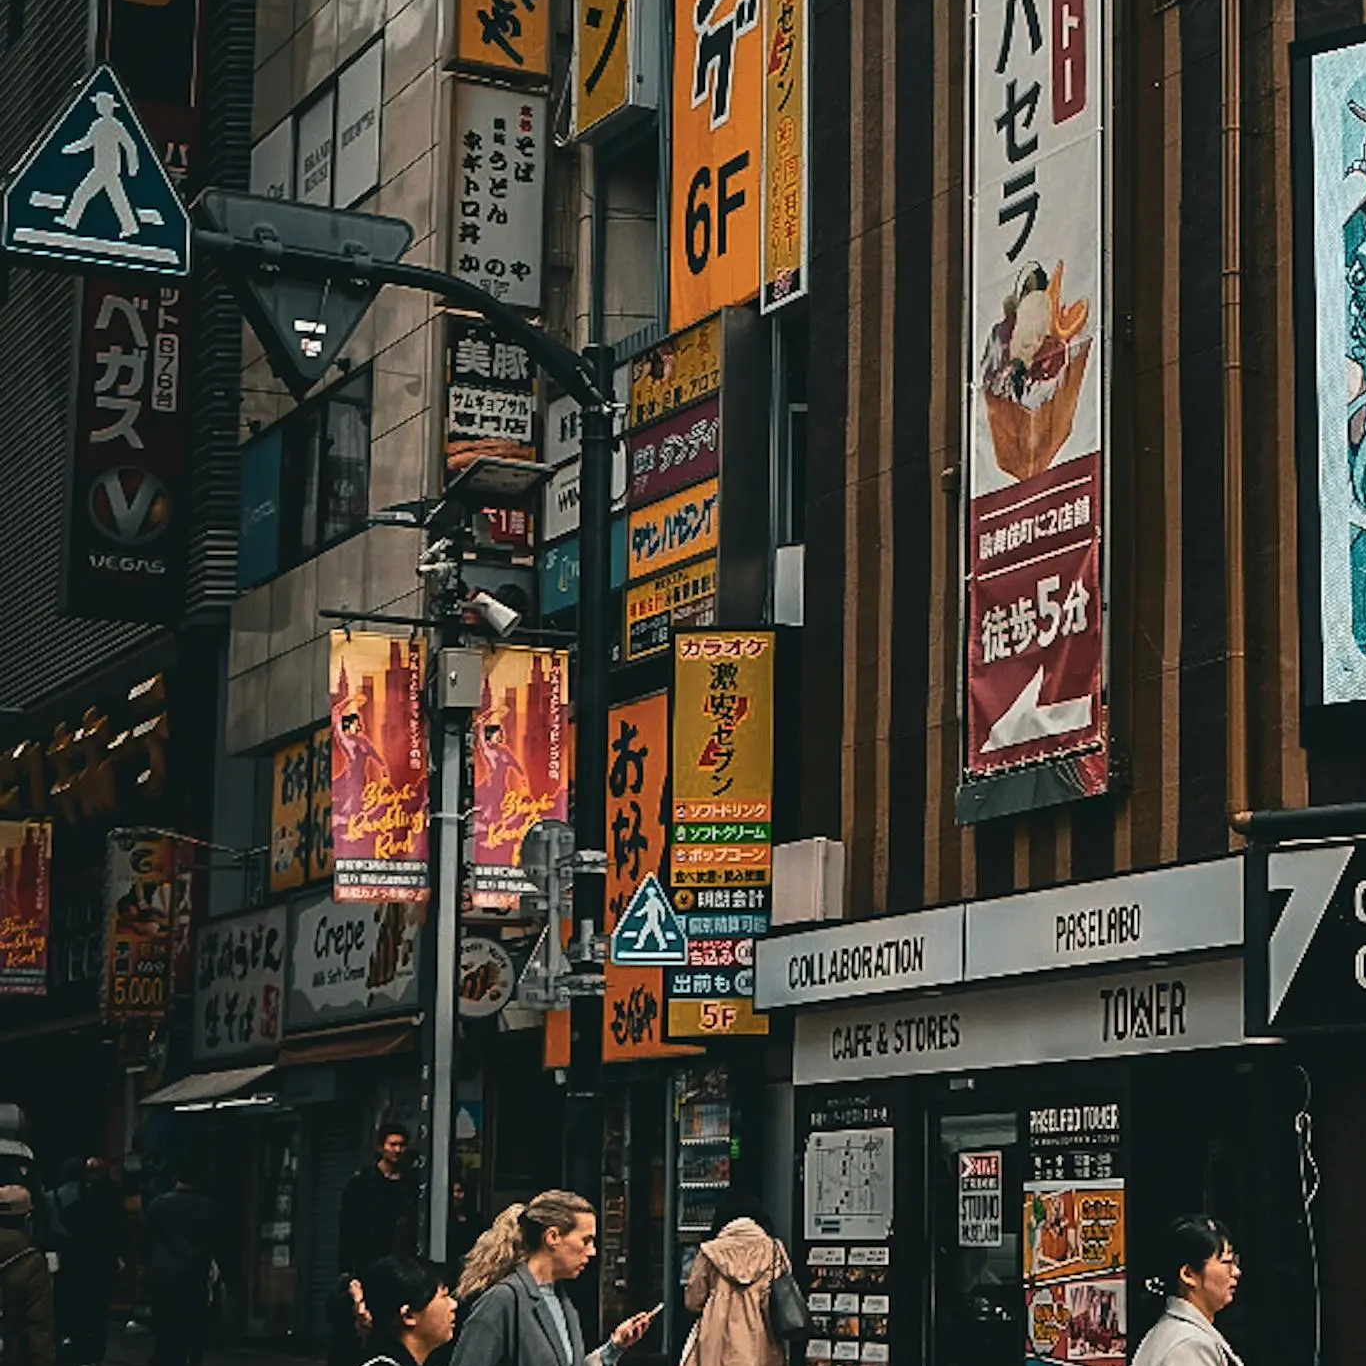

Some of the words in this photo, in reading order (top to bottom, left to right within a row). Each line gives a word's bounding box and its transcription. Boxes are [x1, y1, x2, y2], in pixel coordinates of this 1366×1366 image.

[685, 150, 751, 276] 6F
[89, 293, 151, 450] ベガス
[455, 337, 529, 380] 美豚
[455, 411, 527, 435] 専門店
[979, 495, 1091, 562] 歌舞伎町に2店舗
[87, 553, 168, 576] VEGAS
[981, 574, 1091, 664] 徒歩5分
[679, 637, 768, 658] カラオケ
[708, 662, 740, 797] 激安セブン
[689, 824, 768, 841] ソフトクリーム
[690, 802, 768, 819] ソフトドリンク
[688, 846, 766, 863] ポップコーン
[697, 888, 766, 909] 明朗会計
[314, 915, 365, 966] Crepe
[1055, 904, 1141, 954] PASELABO
[788, 935, 926, 989] COLLABORATION
[699, 1001, 737, 1032] 5F
[1100, 980, 1187, 1043] TOWER
[831, 1022, 873, 1062] CAFE
[877, 1023, 890, 1055] &
[892, 1013, 961, 1056] STORES
